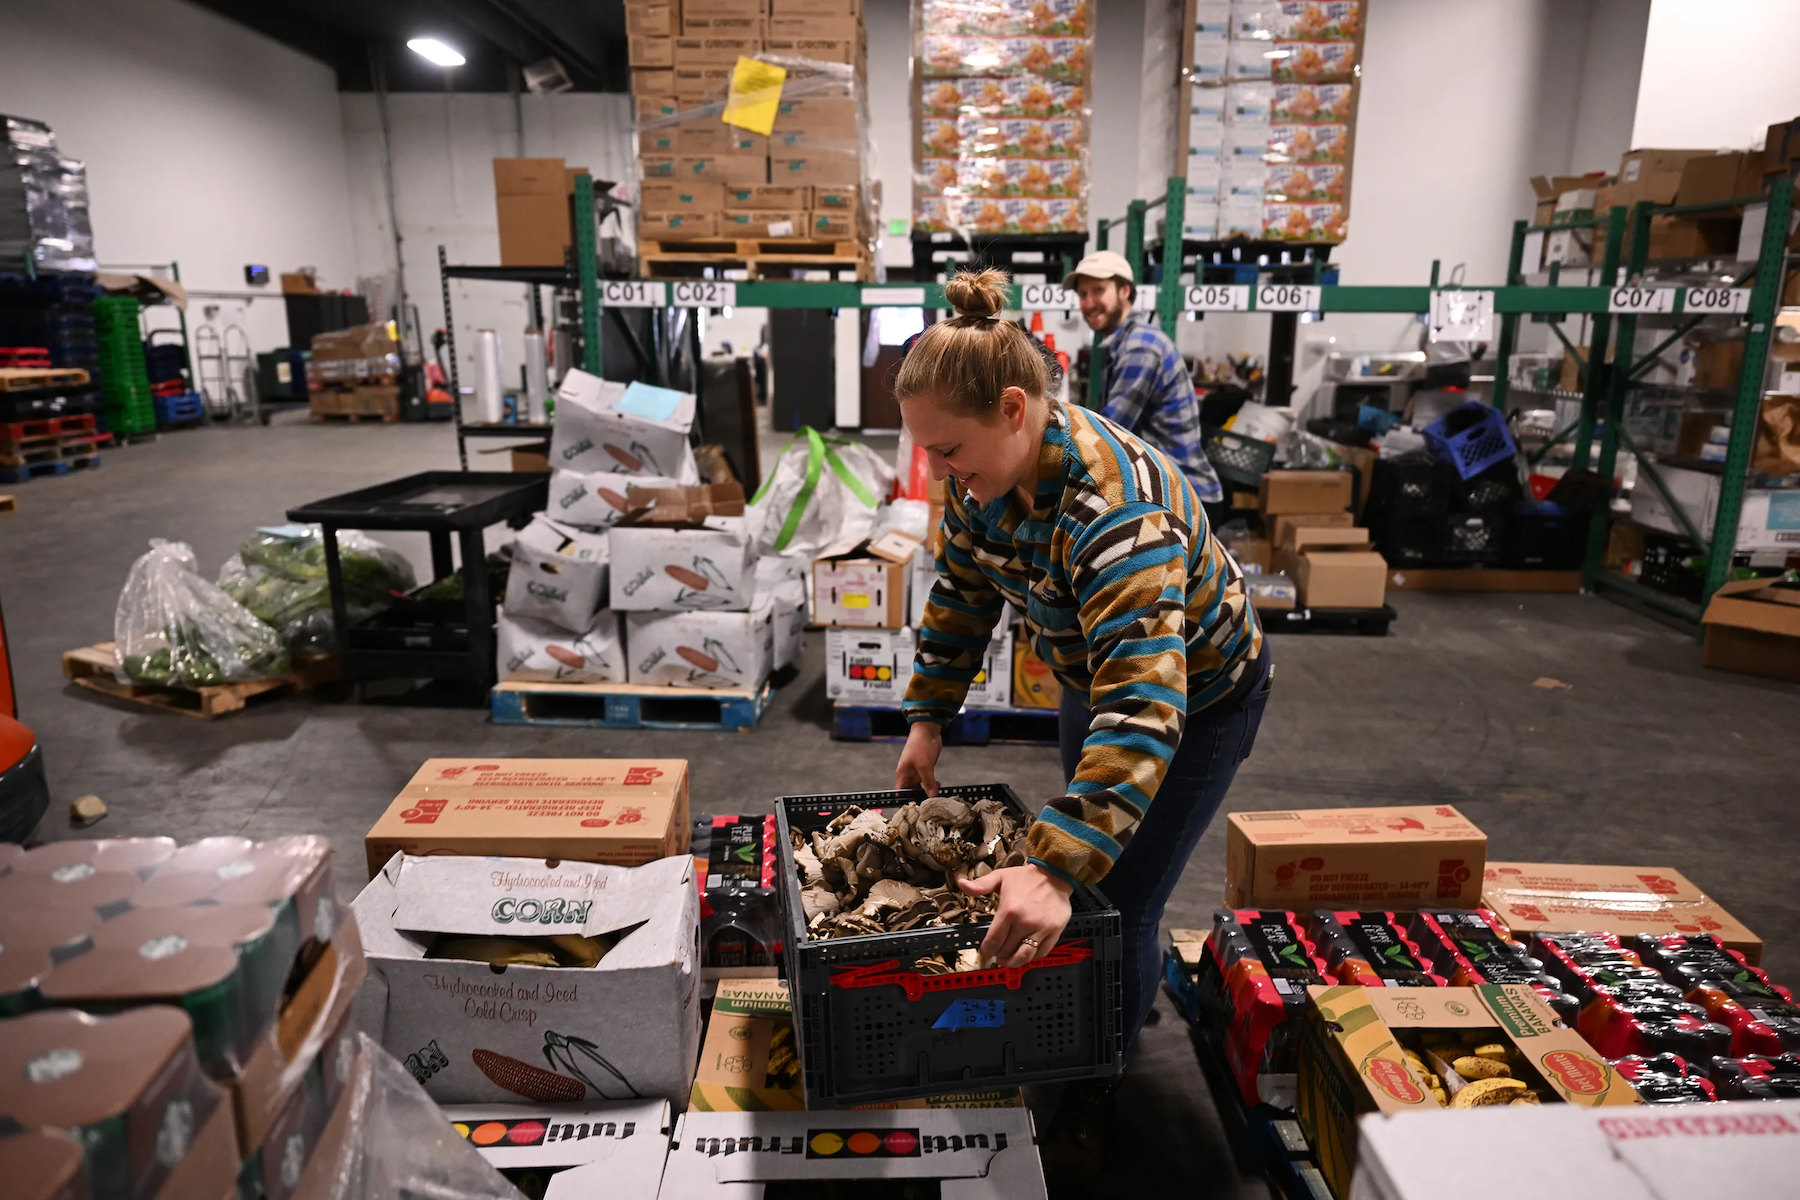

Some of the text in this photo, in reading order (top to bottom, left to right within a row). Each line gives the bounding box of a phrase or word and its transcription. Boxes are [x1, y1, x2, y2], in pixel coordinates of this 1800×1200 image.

[606, 283, 645, 301] C01
[676, 283, 717, 301] C02
[1025, 285, 1067, 304] C03
[1189, 287, 1230, 305] C05
[1260, 286, 1302, 305] C06
[1613, 289, 1655, 308] C07
[1688, 289, 1731, 308] C08
[490, 871, 561, 891] Hydrocooled
[563, 876, 582, 888] and
[1309, 883, 1330, 892] KEEP
[1331, 882, 1389, 891] REFRIGERATED
[1310, 873, 1369, 882] DO NOT FREEZE
[1308, 892, 1359, 901] REFRIGERATE
[1362, 891, 1384, 900] UNTIL
[491, 897, 593, 925] CORN
[423, 974, 578, 1003] Hydrocooled and Iced
[464, 998, 537, 1027] Cold Crisp
[1495, 995, 1534, 1036] Premium
[1505, 987, 1551, 1034] BANANAS
[403, 1039, 450, 1085] RN
[1553, 1053, 1579, 1079] Monte
[696, 1135, 803, 1158] Frutti
